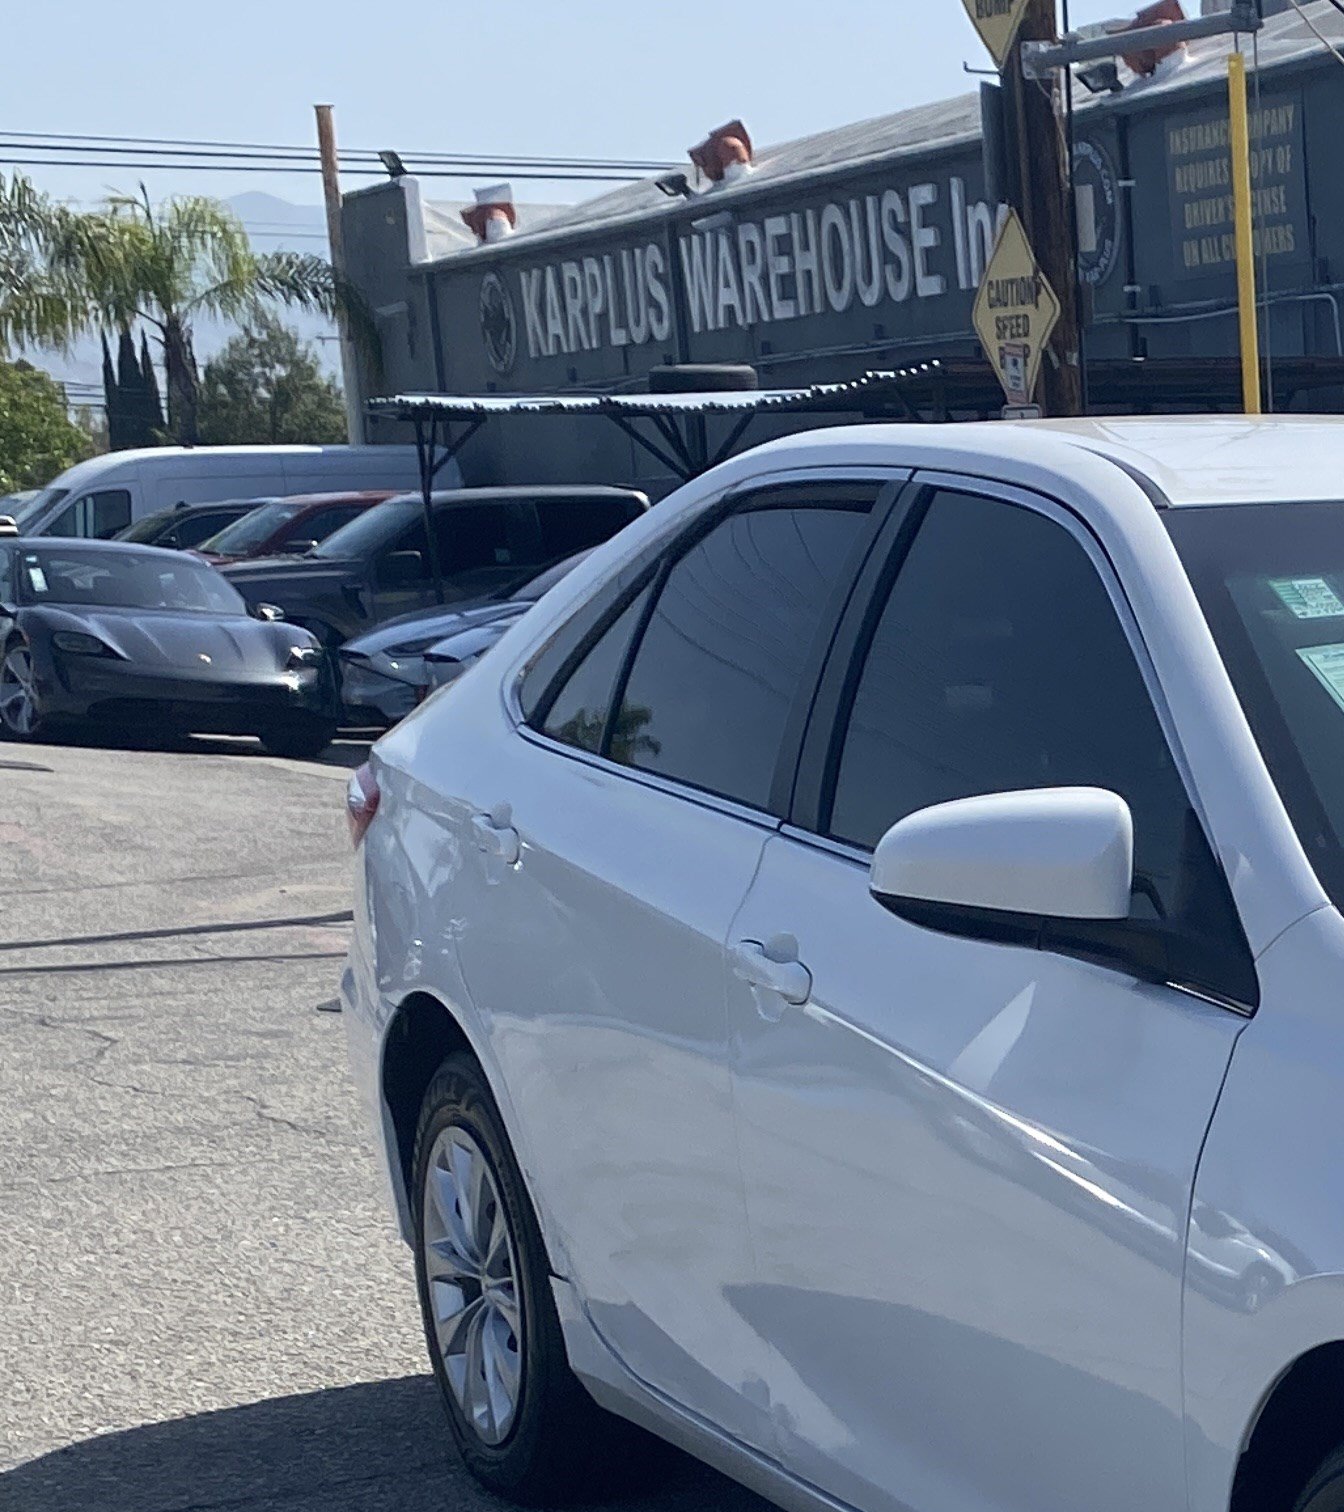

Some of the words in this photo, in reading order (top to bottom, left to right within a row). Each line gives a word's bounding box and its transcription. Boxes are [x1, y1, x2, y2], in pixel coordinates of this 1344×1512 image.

[1251, 148, 1274, 181] OPY
[519, 244, 671, 359] KARPLUS
[679, 182, 947, 334] WAREHOUSE
[995, 313, 1031, 340] SPEED
